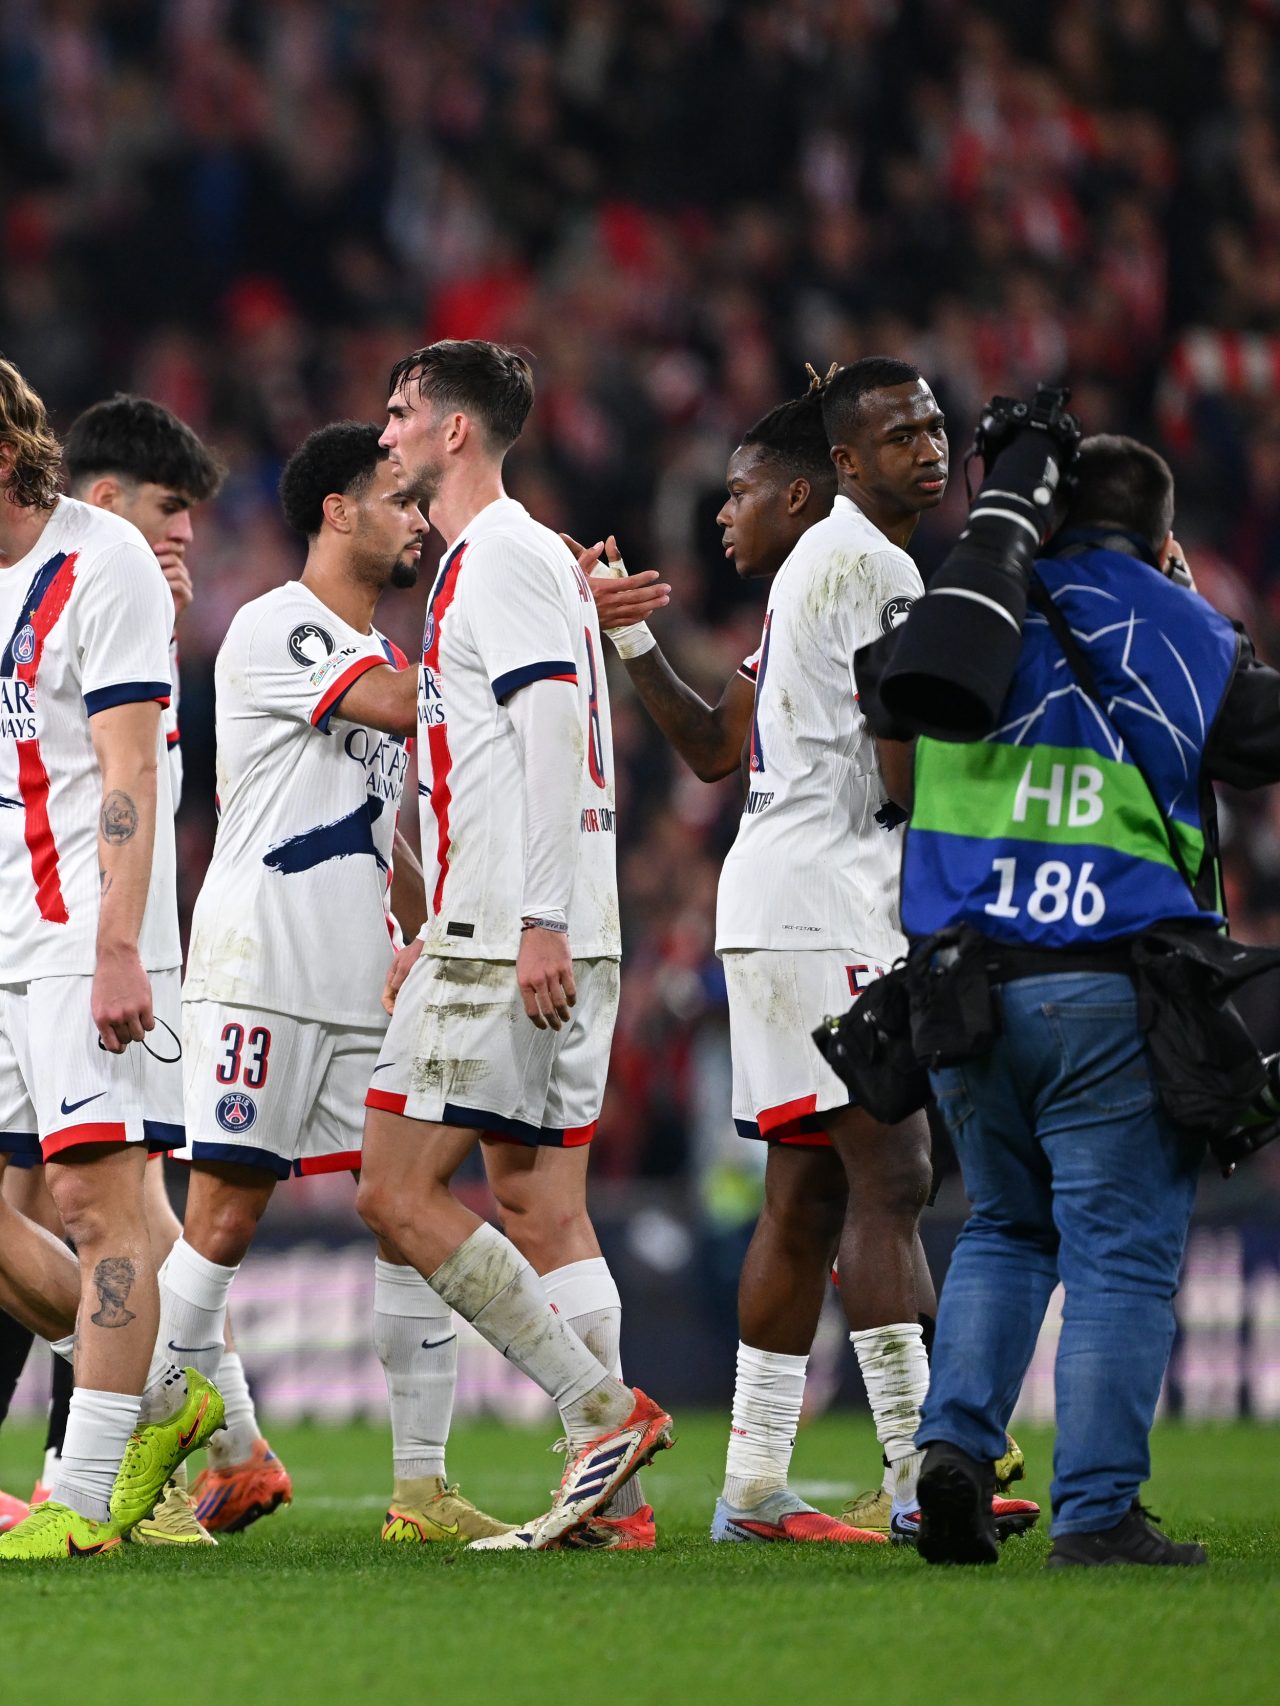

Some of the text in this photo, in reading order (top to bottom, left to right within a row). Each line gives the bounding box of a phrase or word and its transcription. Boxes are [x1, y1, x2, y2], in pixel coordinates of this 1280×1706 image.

[1012, 760, 1104, 827] HB
[984, 857, 1106, 927] 186
[216, 1023, 271, 1089] 33
[224, 1095, 250, 1107] PARIS
